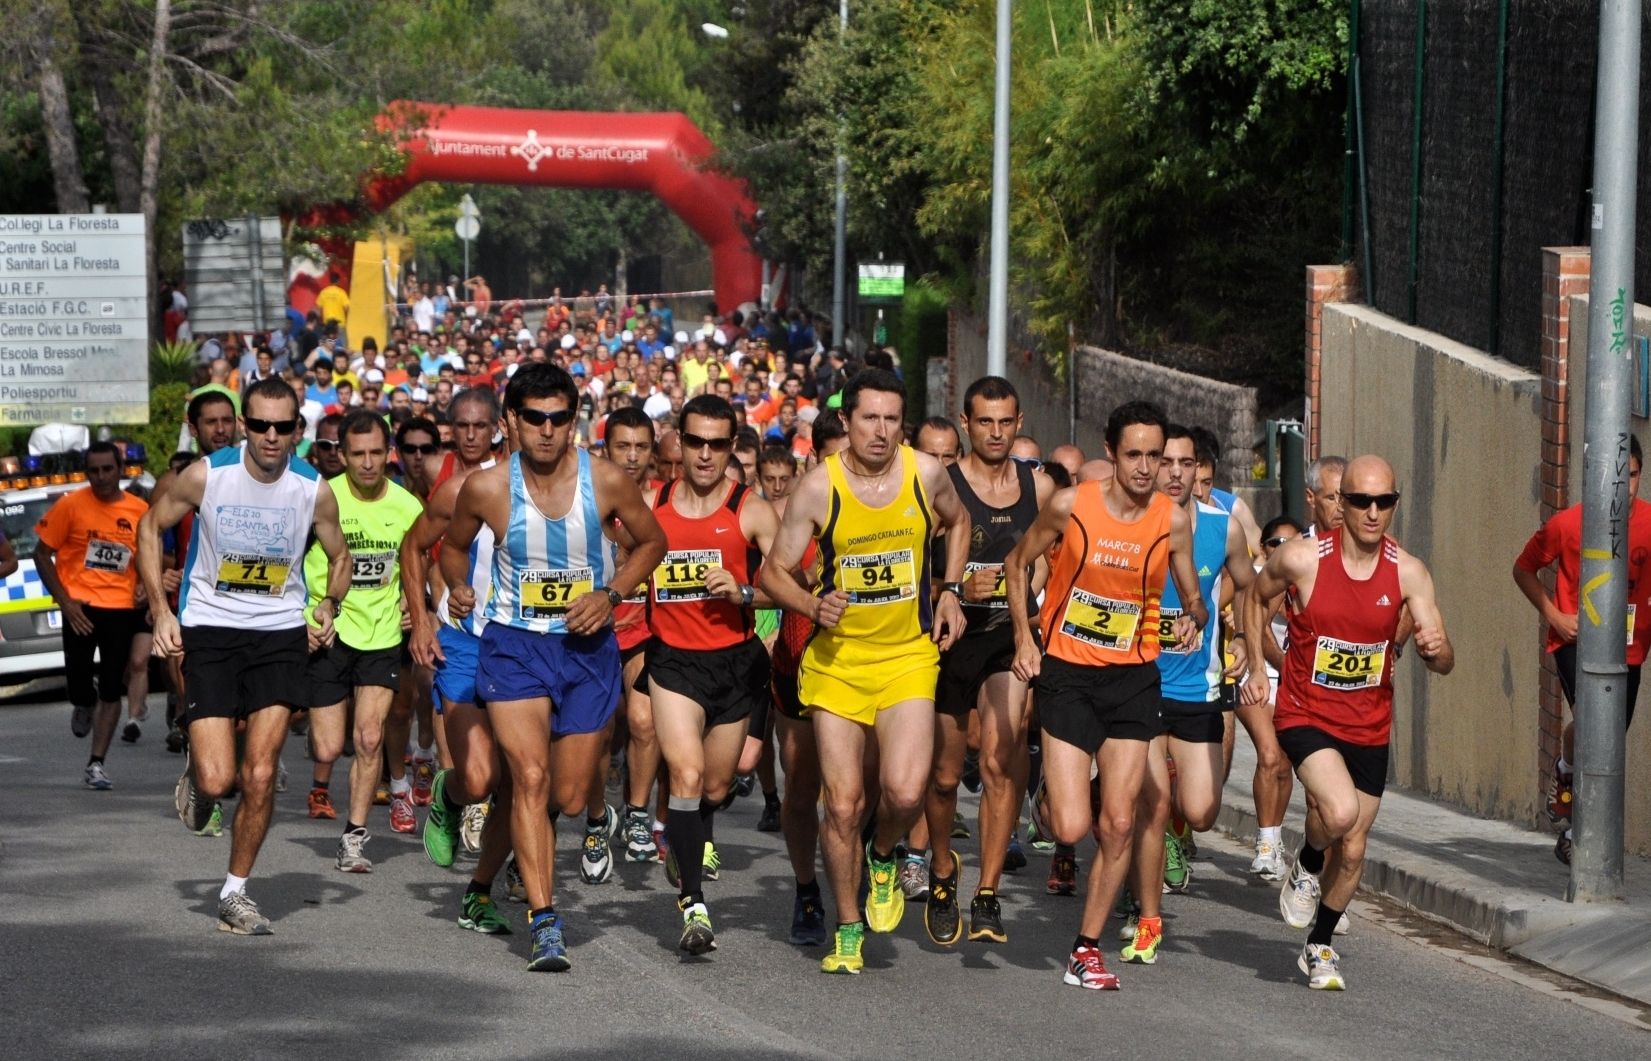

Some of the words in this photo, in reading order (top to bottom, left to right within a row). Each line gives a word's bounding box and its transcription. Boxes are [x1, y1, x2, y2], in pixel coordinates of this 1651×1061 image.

[556, 145, 575, 159] de
[577, 145, 649, 163] SantCugat
[48, 217, 63, 230] La
[69, 216, 120, 230] Floresta
[0, 241, 36, 254] Centre
[41, 240, 77, 254] Social
[6, 257, 49, 271] Sanitari
[54, 256, 68, 270] La
[73, 256, 120, 270] Floresta
[0, 300, 46, 315] Estació
[52, 300, 91, 315] F.G.C.
[0, 322, 33, 336] Centre
[66, 322, 78, 335] La
[83, 321, 122, 335] Floresta
[0, 346, 38, 360] Escola
[43, 346, 87, 359] Bressol
[1, 364, 15, 377] La
[20, 363, 64, 376] Mimosa
[1, 386, 77, 401] Poliesportiu
[5, 504, 25, 516] 092
[220, 517, 234, 527] DE
[235, 519, 270, 532] SANTA
[344, 531, 365, 541] URSA
[847, 533, 877, 546] DOMINGO
[877, 528, 904, 541] CATALAN
[1097, 538, 1141, 554] MARC78
[94, 548, 123, 563] 404
[667, 551, 689, 560] CURSA
[689, 550, 720, 560] POPULAR
[857, 555, 880, 565] CURSA
[880, 549, 911, 561] POPULAR
[241, 564, 269, 581] 71
[352, 562, 386, 576] 429
[561, 567, 592, 579] POPULAR
[665, 563, 709, 584] 118
[861, 565, 895, 587] 94
[541, 583, 573, 602] 67
[1089, 594, 1111, 608] CURSA
[1093, 611, 1112, 630] 2
[1335, 641, 1357, 653] CURSA
[1328, 652, 1373, 673] 201
